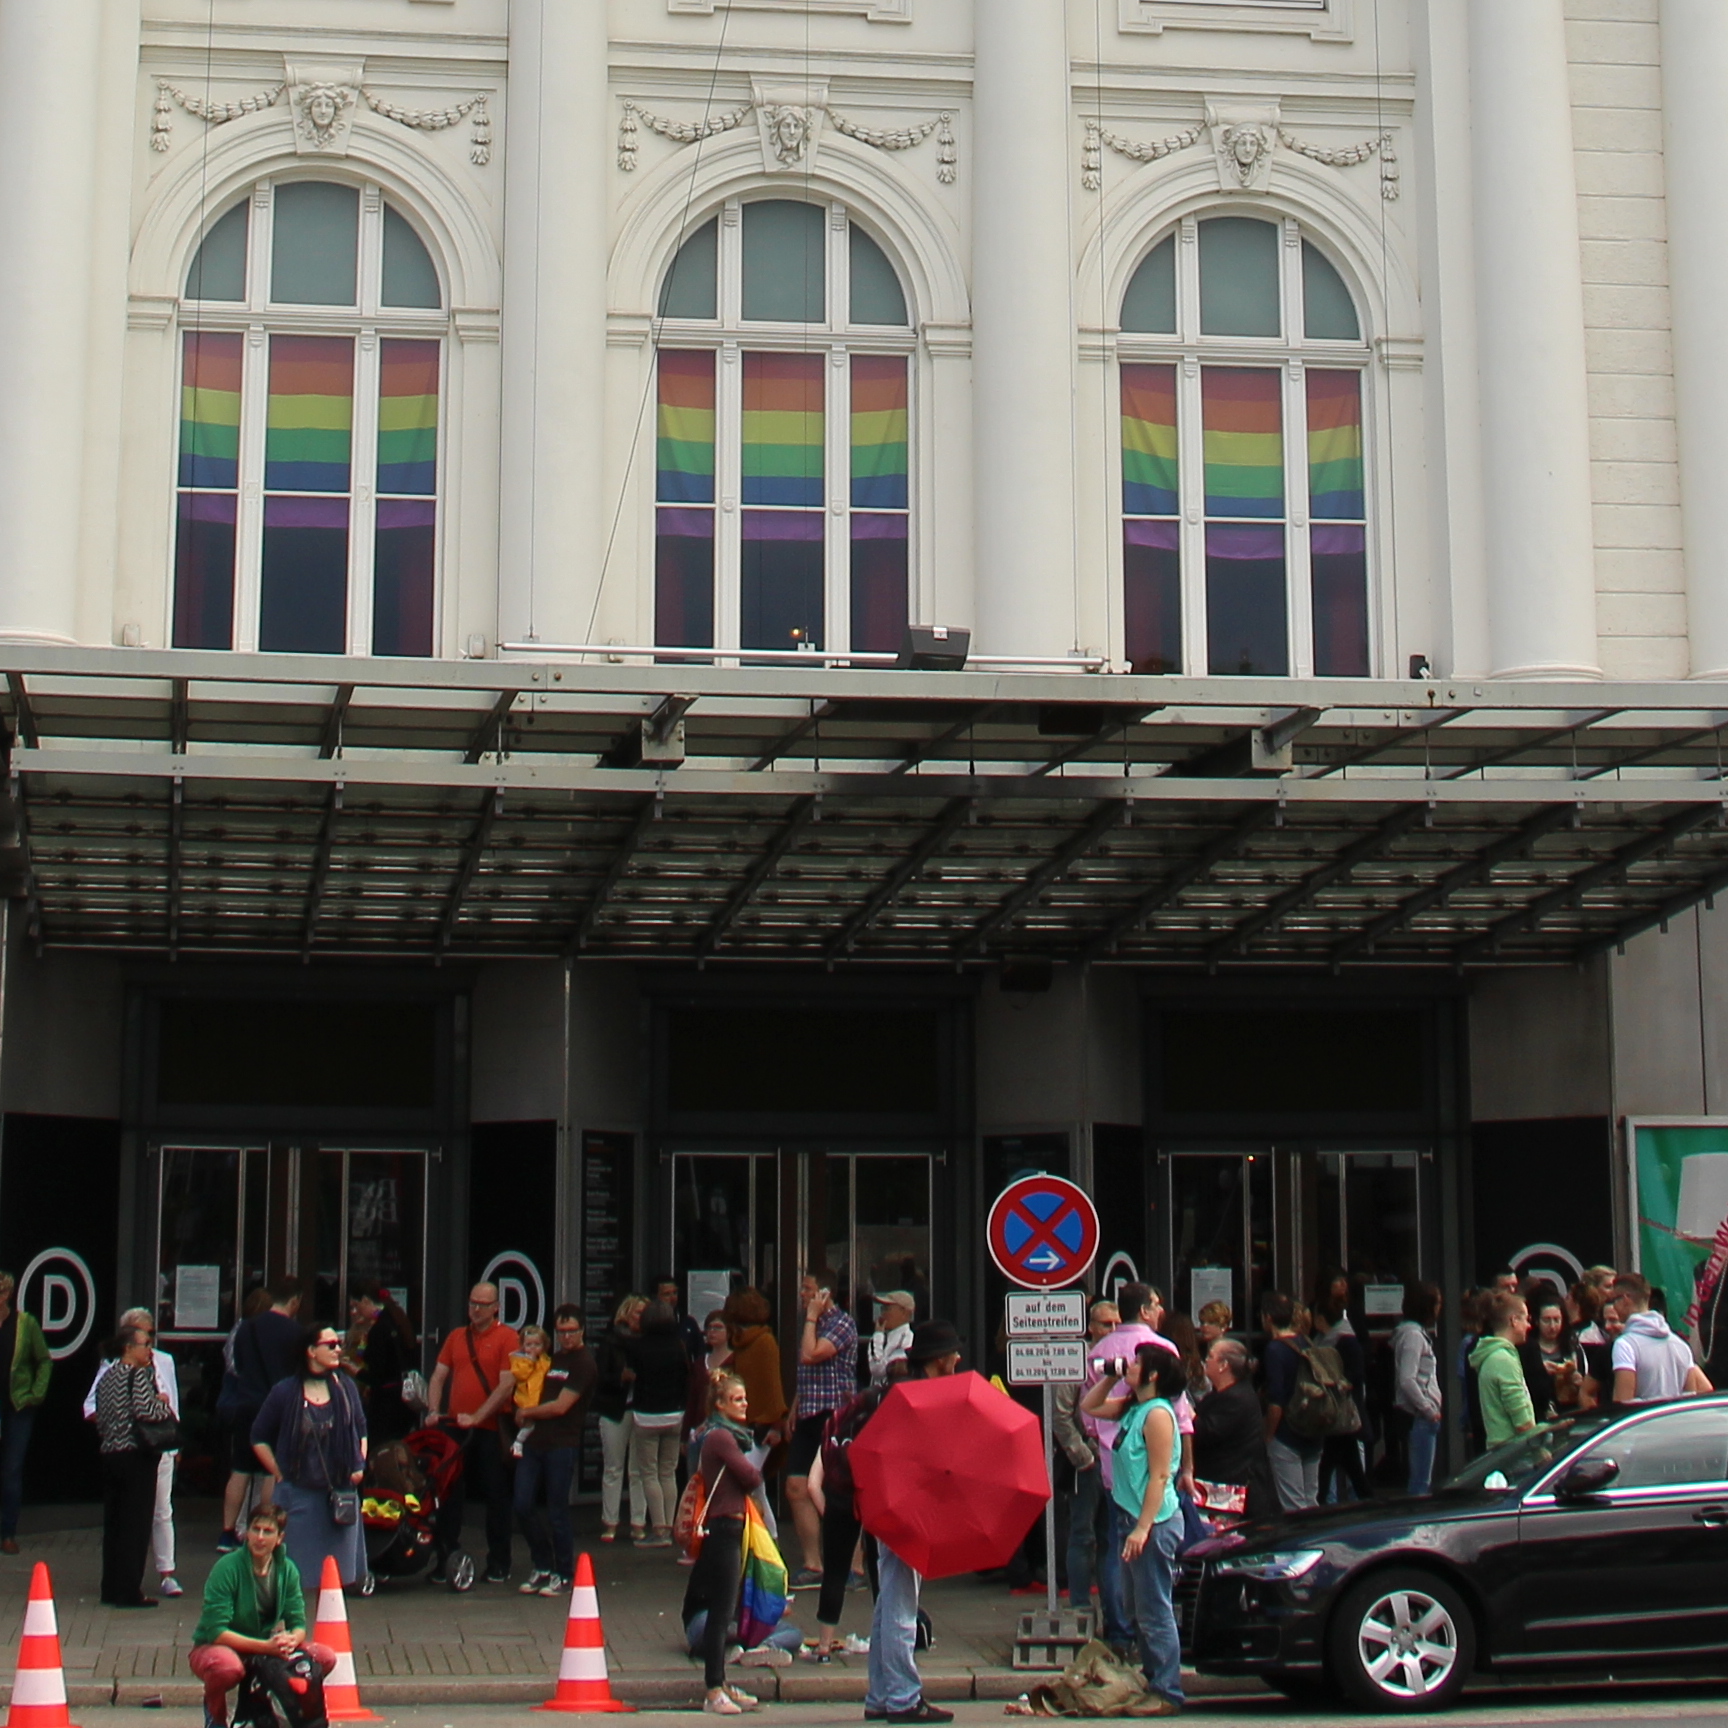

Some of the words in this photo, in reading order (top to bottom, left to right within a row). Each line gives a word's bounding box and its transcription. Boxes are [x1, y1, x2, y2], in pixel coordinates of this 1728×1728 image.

[1025, 1302, 1040, 1313] auf
[1045, 1301, 1066, 1313] dem
[1013, 1315, 1080, 1328] Seitenstreifen
[1681, 1303, 1704, 1328] in
